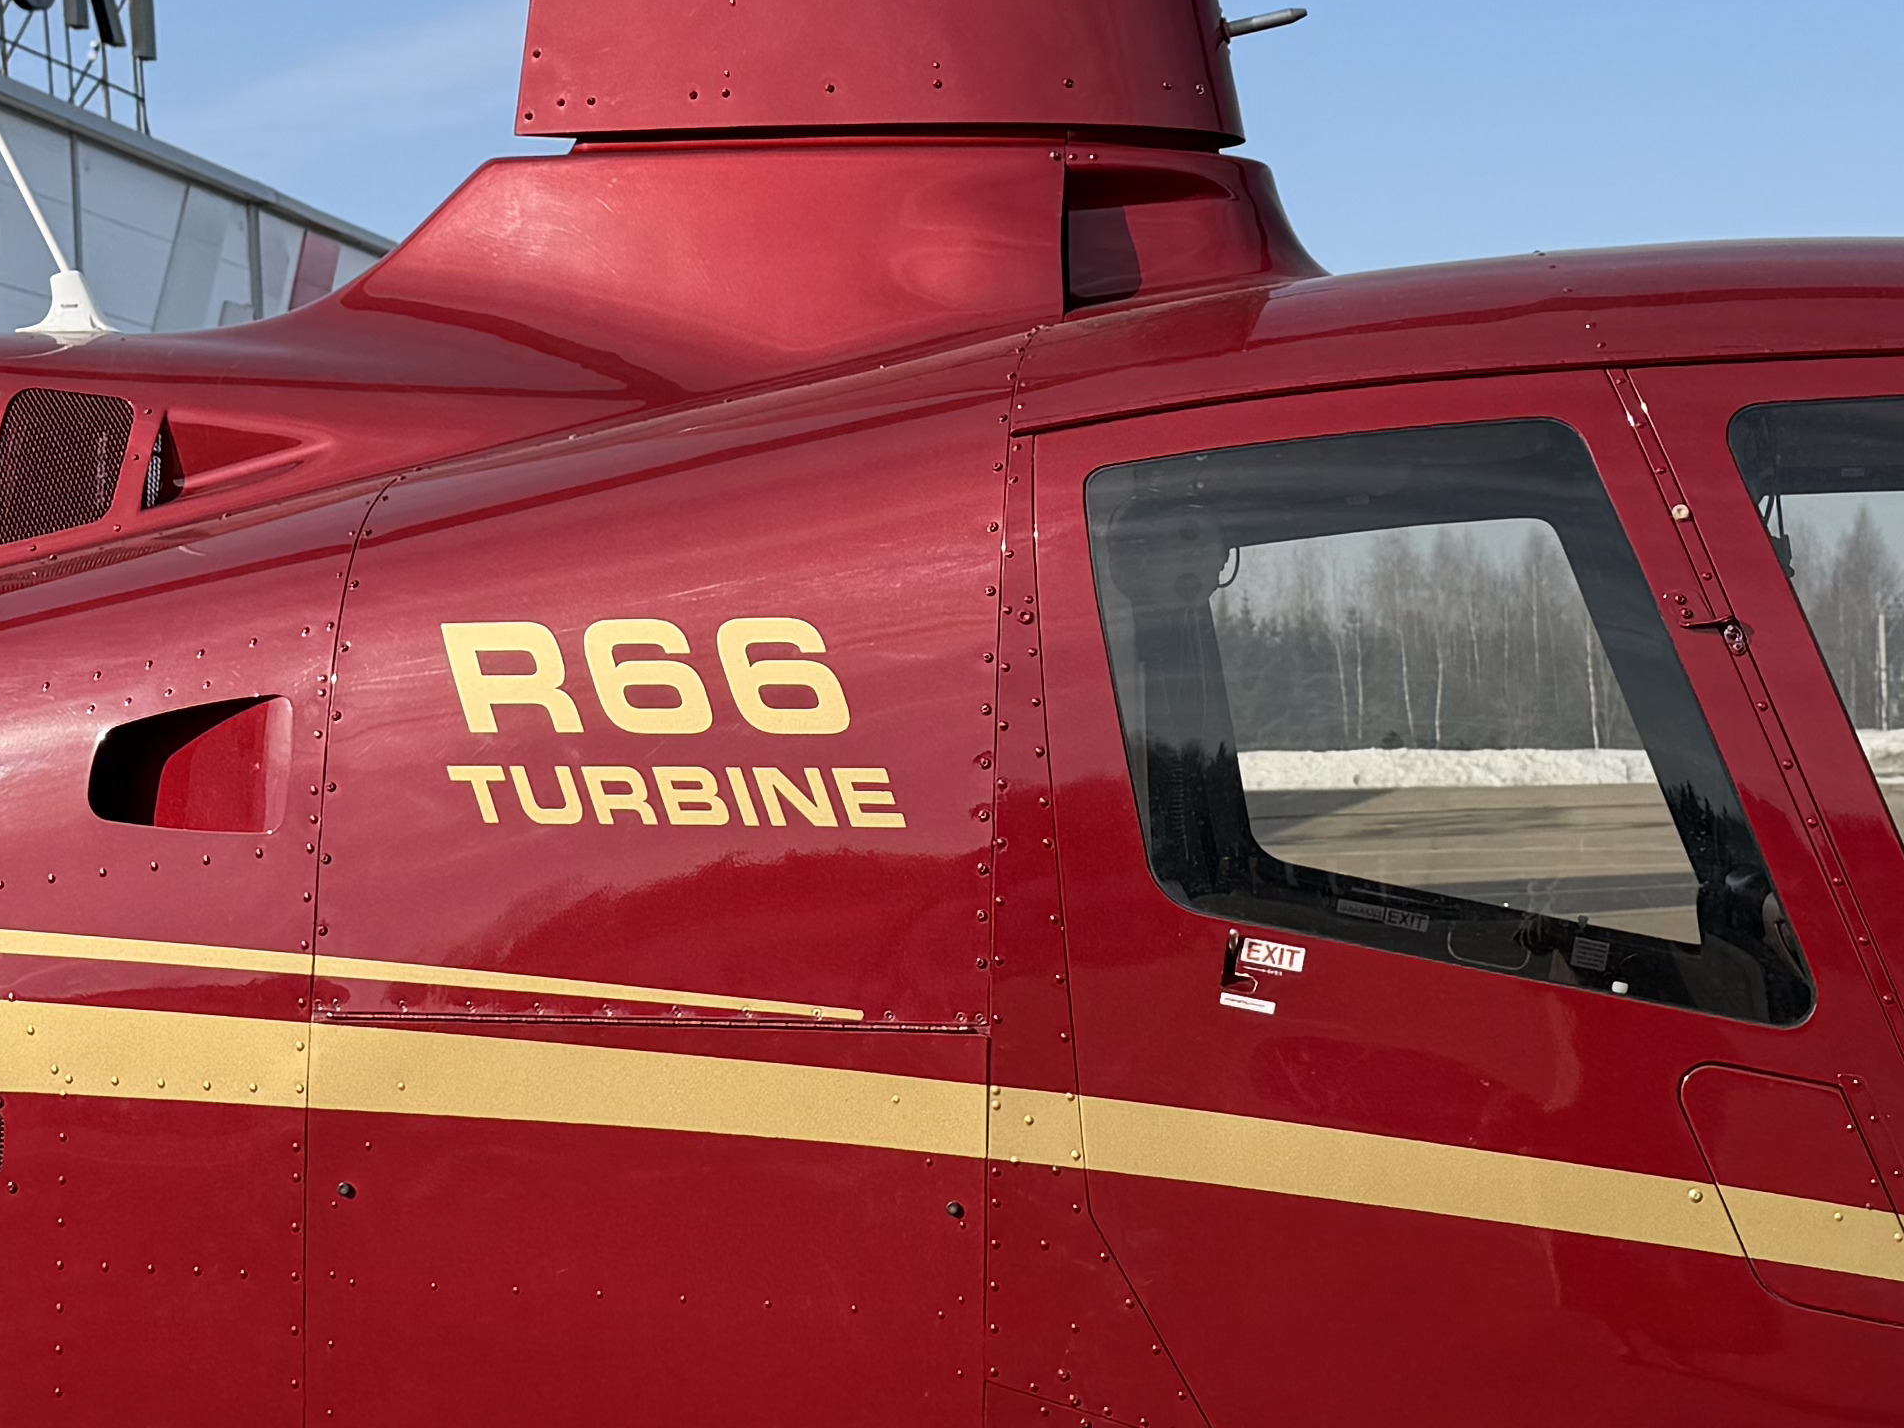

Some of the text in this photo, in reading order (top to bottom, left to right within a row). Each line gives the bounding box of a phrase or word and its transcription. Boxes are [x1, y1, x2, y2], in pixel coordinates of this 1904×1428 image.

[440, 617, 851, 735] R66
[446, 765, 907, 829] TURBINE
[1388, 910, 1426, 929] EXIT
[1246, 941, 1301, 968] EXIT
